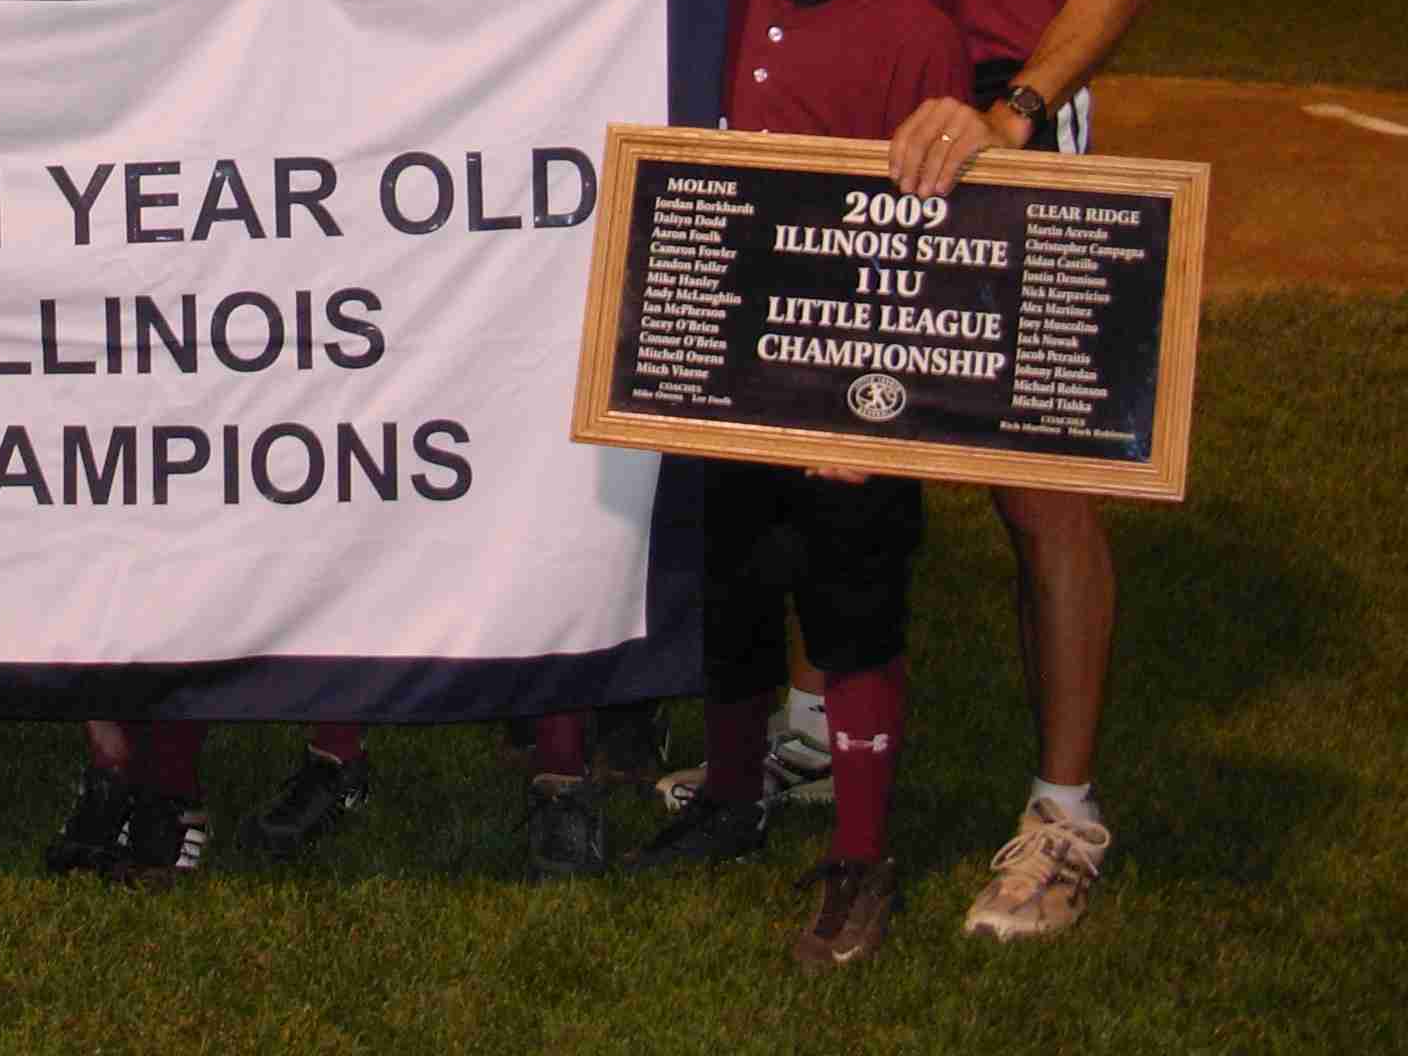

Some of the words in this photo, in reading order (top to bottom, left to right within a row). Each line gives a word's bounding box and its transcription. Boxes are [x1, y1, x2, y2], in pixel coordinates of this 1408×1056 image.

[667, 177, 737, 196] MOLINE
[46, 156, 344, 245] YEAR
[379, 147, 598, 235] OLD
[655, 197, 693, 210] Jordan
[843, 191, 948, 229] 2009
[1026, 204, 1082, 221] CLEAR
[1085, 207, 1141, 225] RIDGE
[694, 214, 727, 228] Dodd
[652, 226, 687, 240] Aaron
[774, 224, 908, 260] ILLINOIS
[916, 235, 1009, 267] STATE
[647, 271, 677, 285] Mike
[644, 286, 674, 301] Andy
[643, 301, 662, 313] Ian
[767, 296, 871, 330] LITTLE
[879, 305, 1002, 341] LEAGUE
[757, 334, 1005, 378] CHAMPIONSHIP
[636, 362, 669, 375] Mitch
